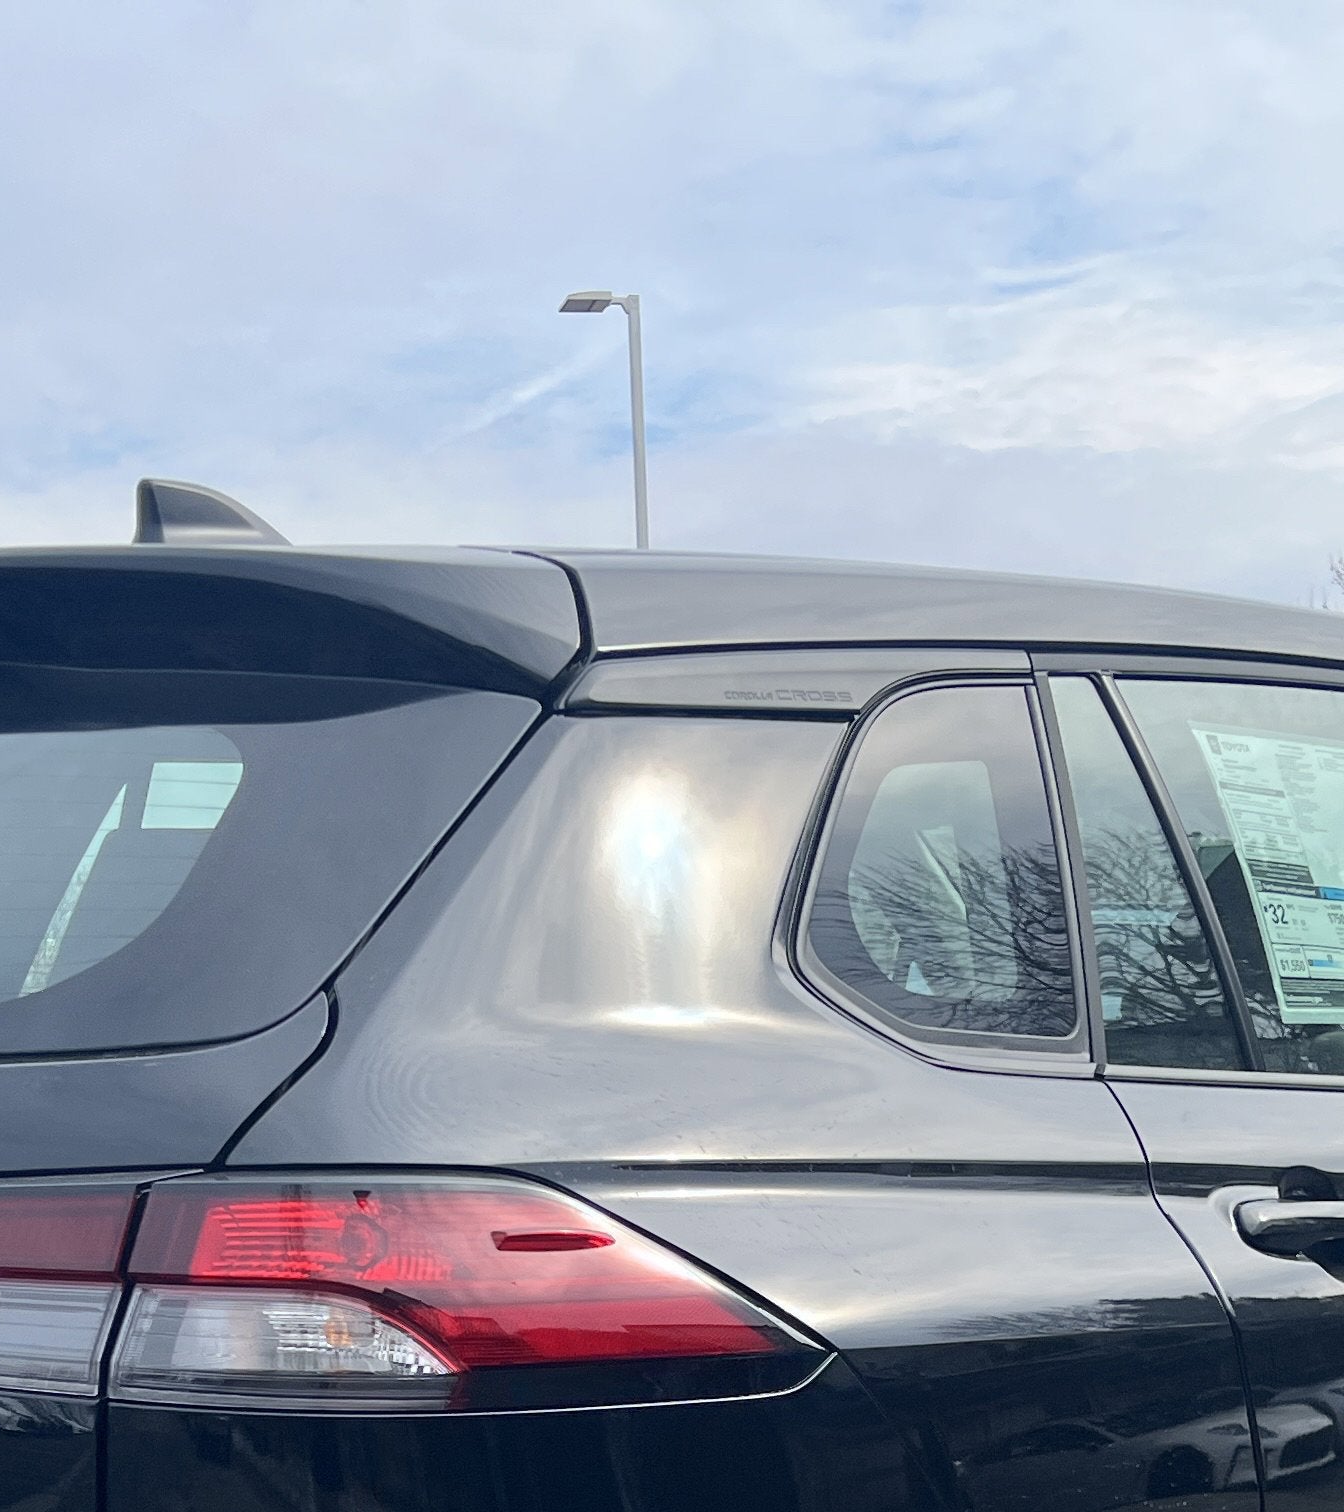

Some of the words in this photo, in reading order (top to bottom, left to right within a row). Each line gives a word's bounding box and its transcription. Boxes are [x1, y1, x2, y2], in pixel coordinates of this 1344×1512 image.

[724, 690, 773, 701] COROLLA
[774, 689, 853, 703] CROSS
[1268, 904, 1288, 924] 32
